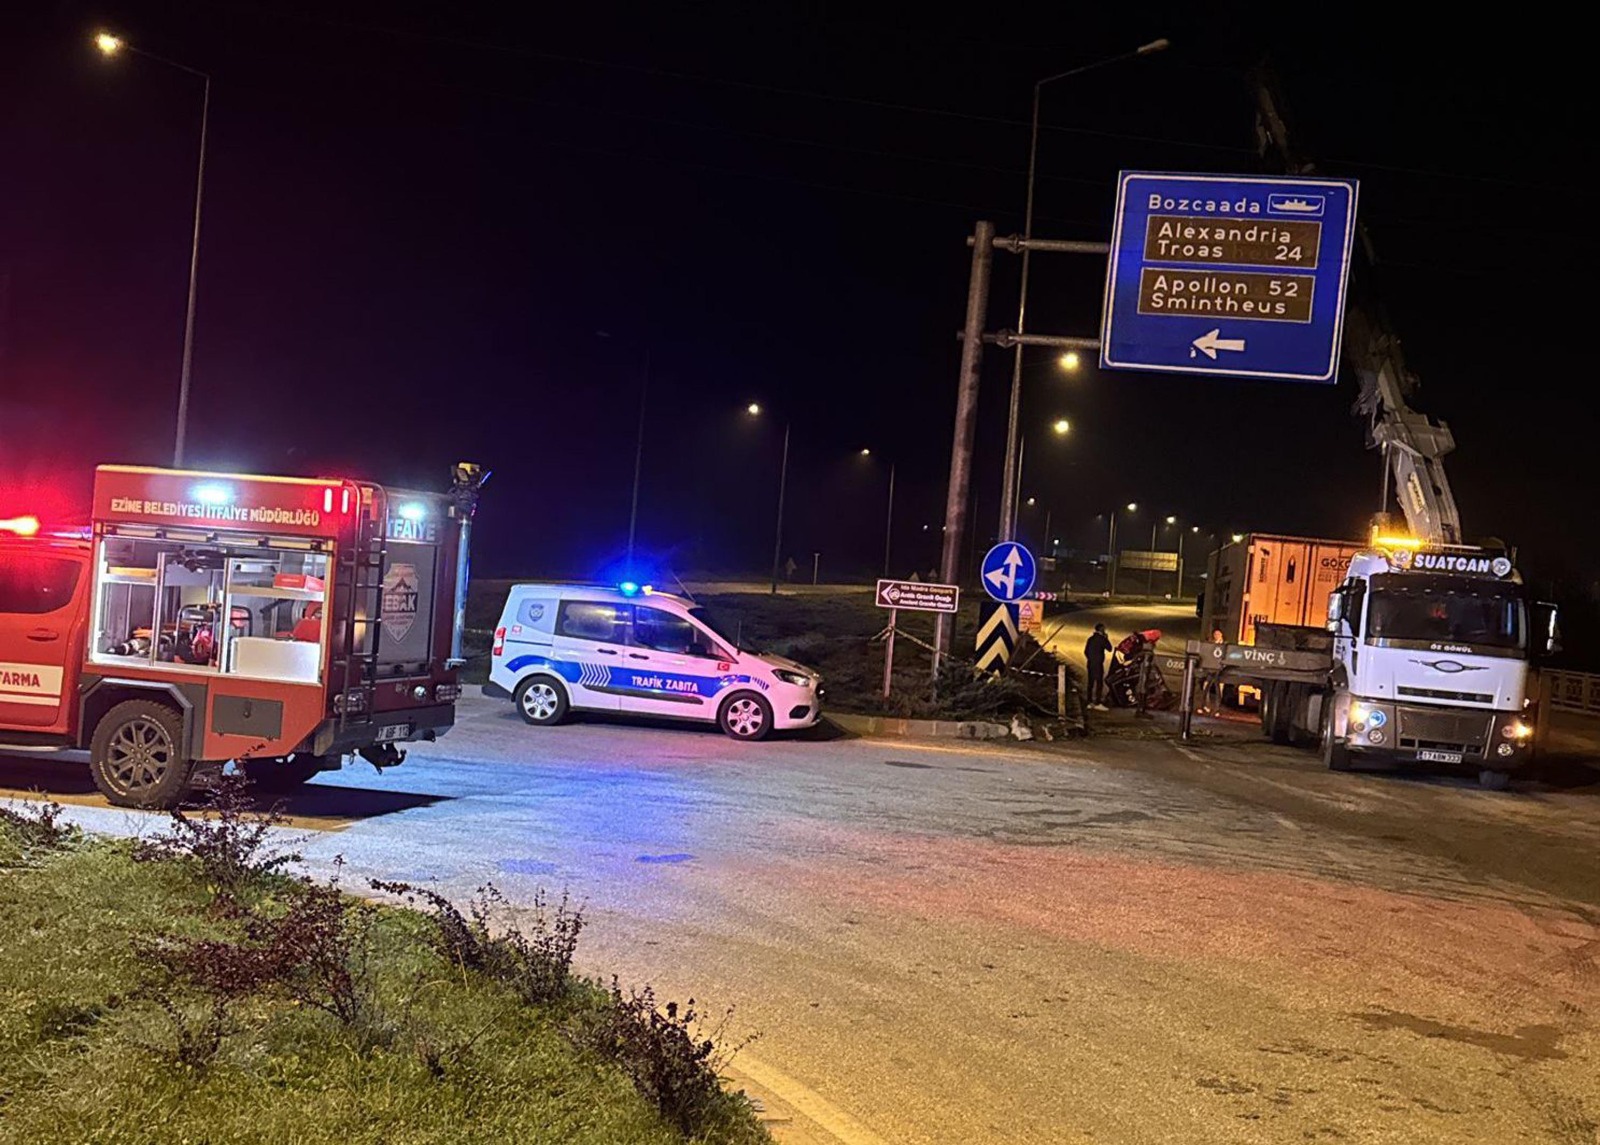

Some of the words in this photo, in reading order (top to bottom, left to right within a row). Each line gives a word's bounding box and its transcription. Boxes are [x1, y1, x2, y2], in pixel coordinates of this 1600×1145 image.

[1148, 194, 1260, 213] Bozcaada
[1158, 222, 1291, 244] Alexandria
[1157, 240, 1223, 258] Troas
[1275, 246, 1302, 261] 24
[1153, 275, 1247, 295] Apollon
[1269, 280, 1298, 297] 52
[1151, 293, 1286, 314] Smintheus
[111, 497, 142, 513] EZİNE
[144, 501, 205, 518] BELEDİYESİ
[206, 503, 248, 521] İTFAİYE
[250, 506, 319, 526] MÜDÜRLÜĞÜ
[386, 519, 436, 541] TFAİYE
[1414, 554, 1490, 573] SUATCAN
[1244, 649, 1275, 665] VİNÇ
[632, 675, 663, 688] TRAFİK
[665, 679, 698, 692] ZABITA
